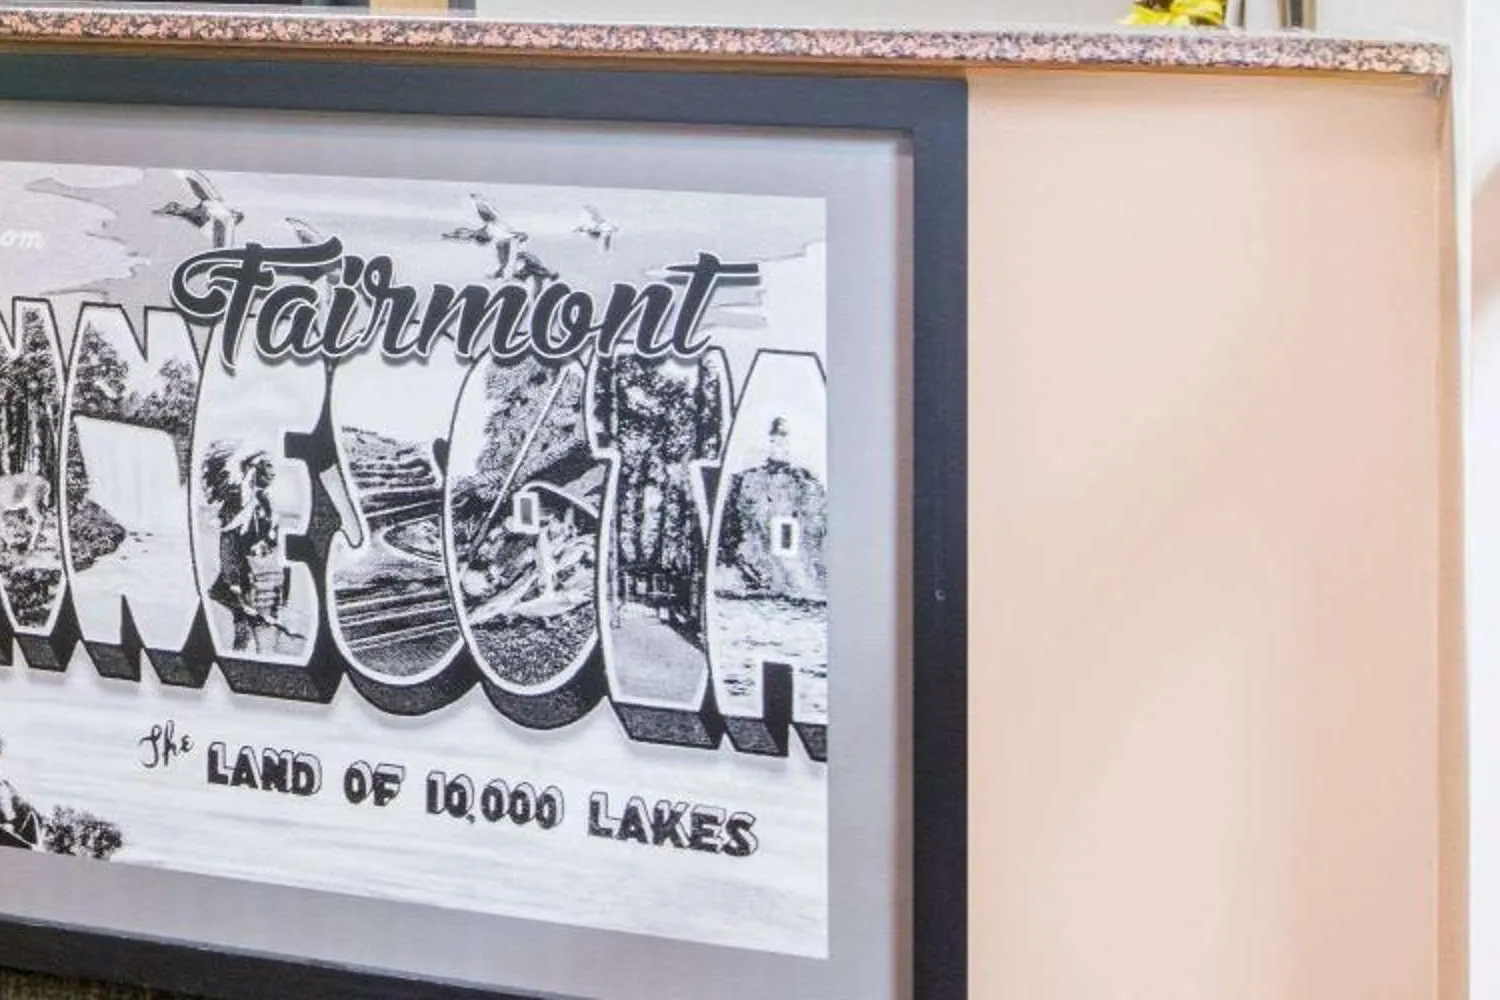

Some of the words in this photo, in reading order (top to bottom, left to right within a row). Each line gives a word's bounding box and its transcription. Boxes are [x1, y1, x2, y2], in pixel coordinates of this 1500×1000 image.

[169, 236, 761, 373] Fairmont
[136, 719, 194, 769] The
[206, 741, 323, 797] LAND
[343, 758, 406, 808] OF
[425, 769, 566, 830] 10,000
[587, 790, 760, 858] LAKES
